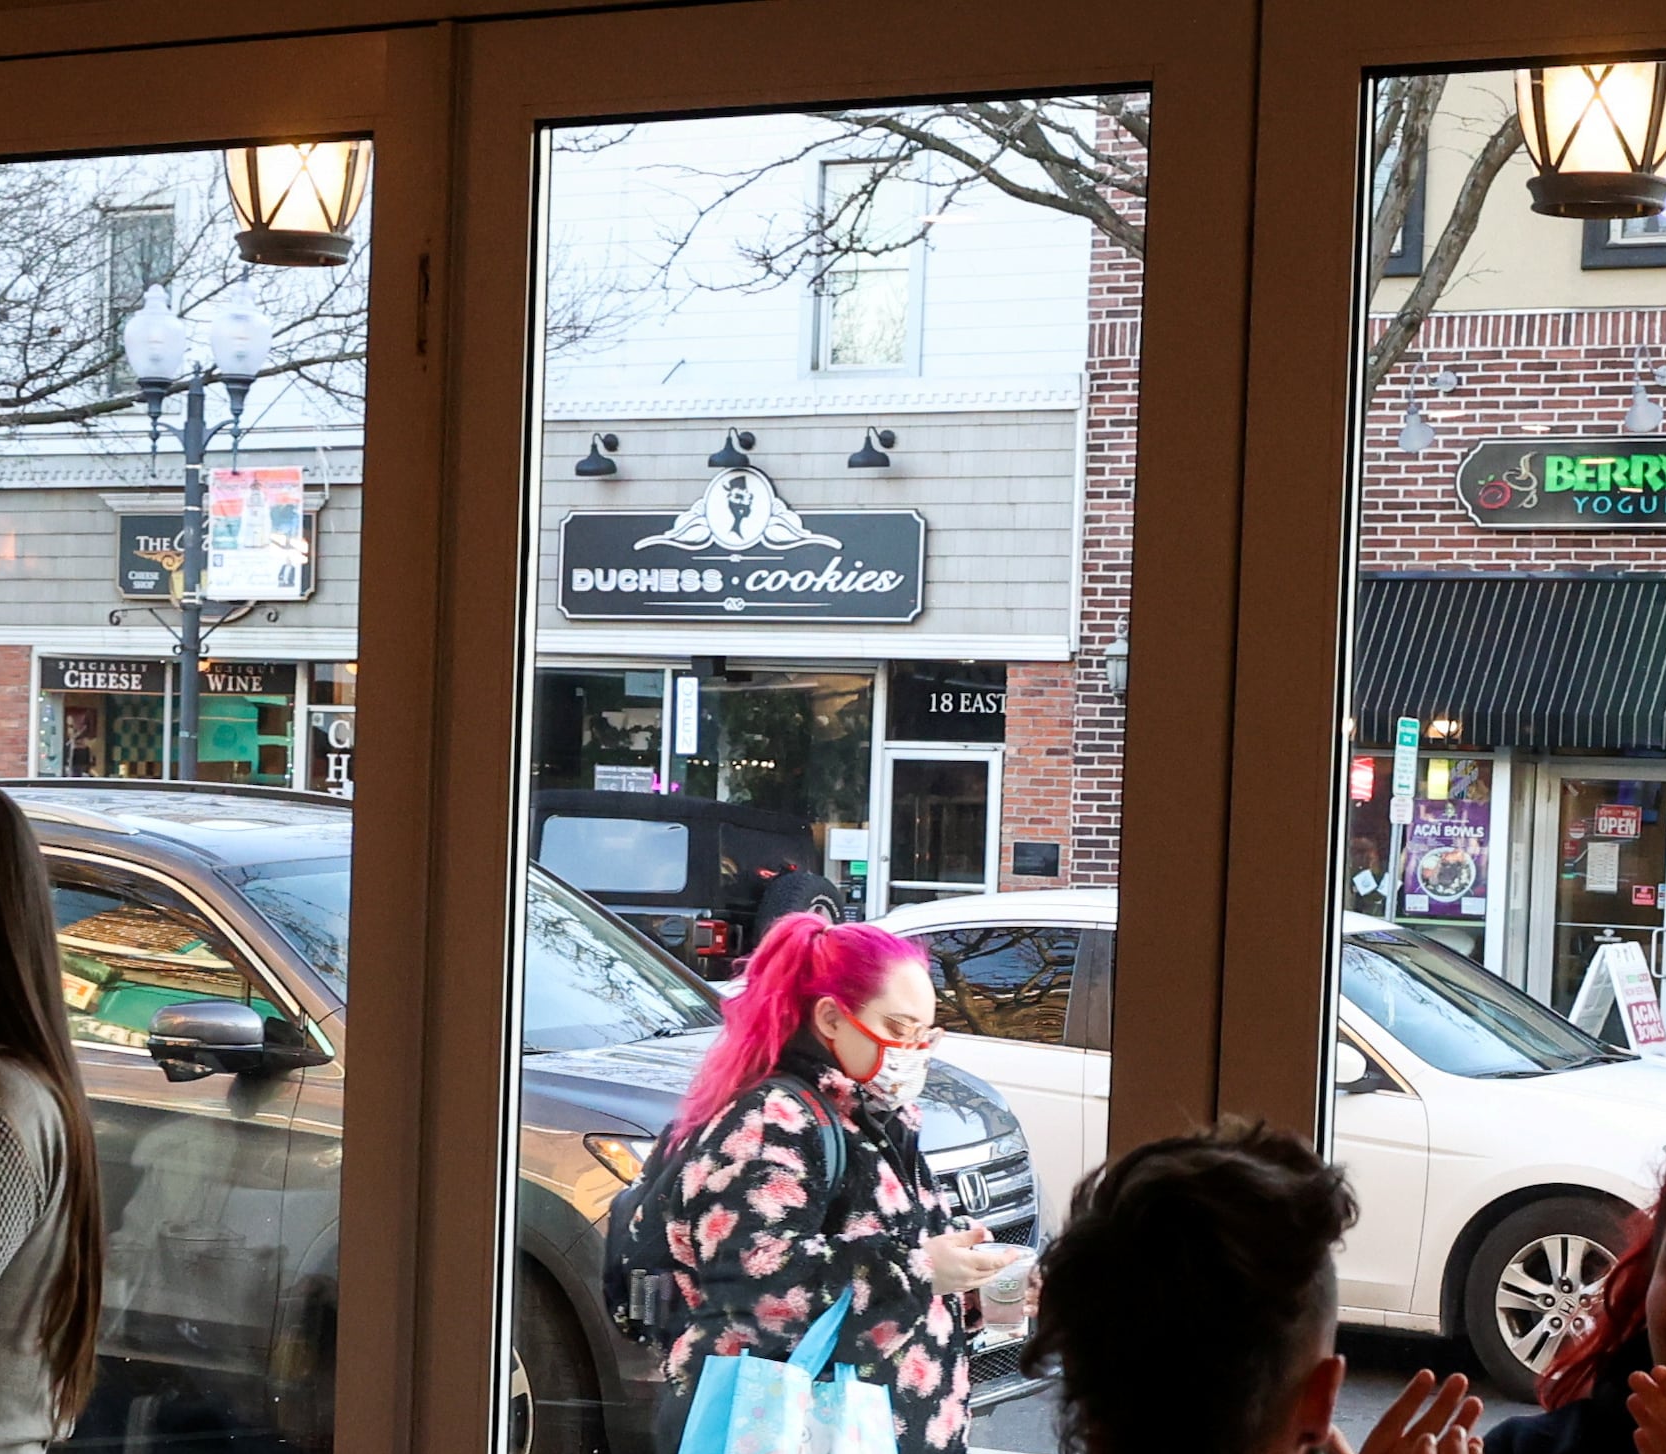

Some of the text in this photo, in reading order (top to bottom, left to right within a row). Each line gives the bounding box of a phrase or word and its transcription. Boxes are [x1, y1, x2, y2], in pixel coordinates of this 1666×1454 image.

[136, 536, 172, 551] THE
[572, 556, 906, 593] DUCHESS cookies
[64, 669, 142, 691] CHEESE
[208, 673, 263, 693] WINE
[929, 692, 1007, 714] 18 EAST
[1444, 825, 1485, 838] BOWLS
[1597, 816, 1637, 835] OPEN
